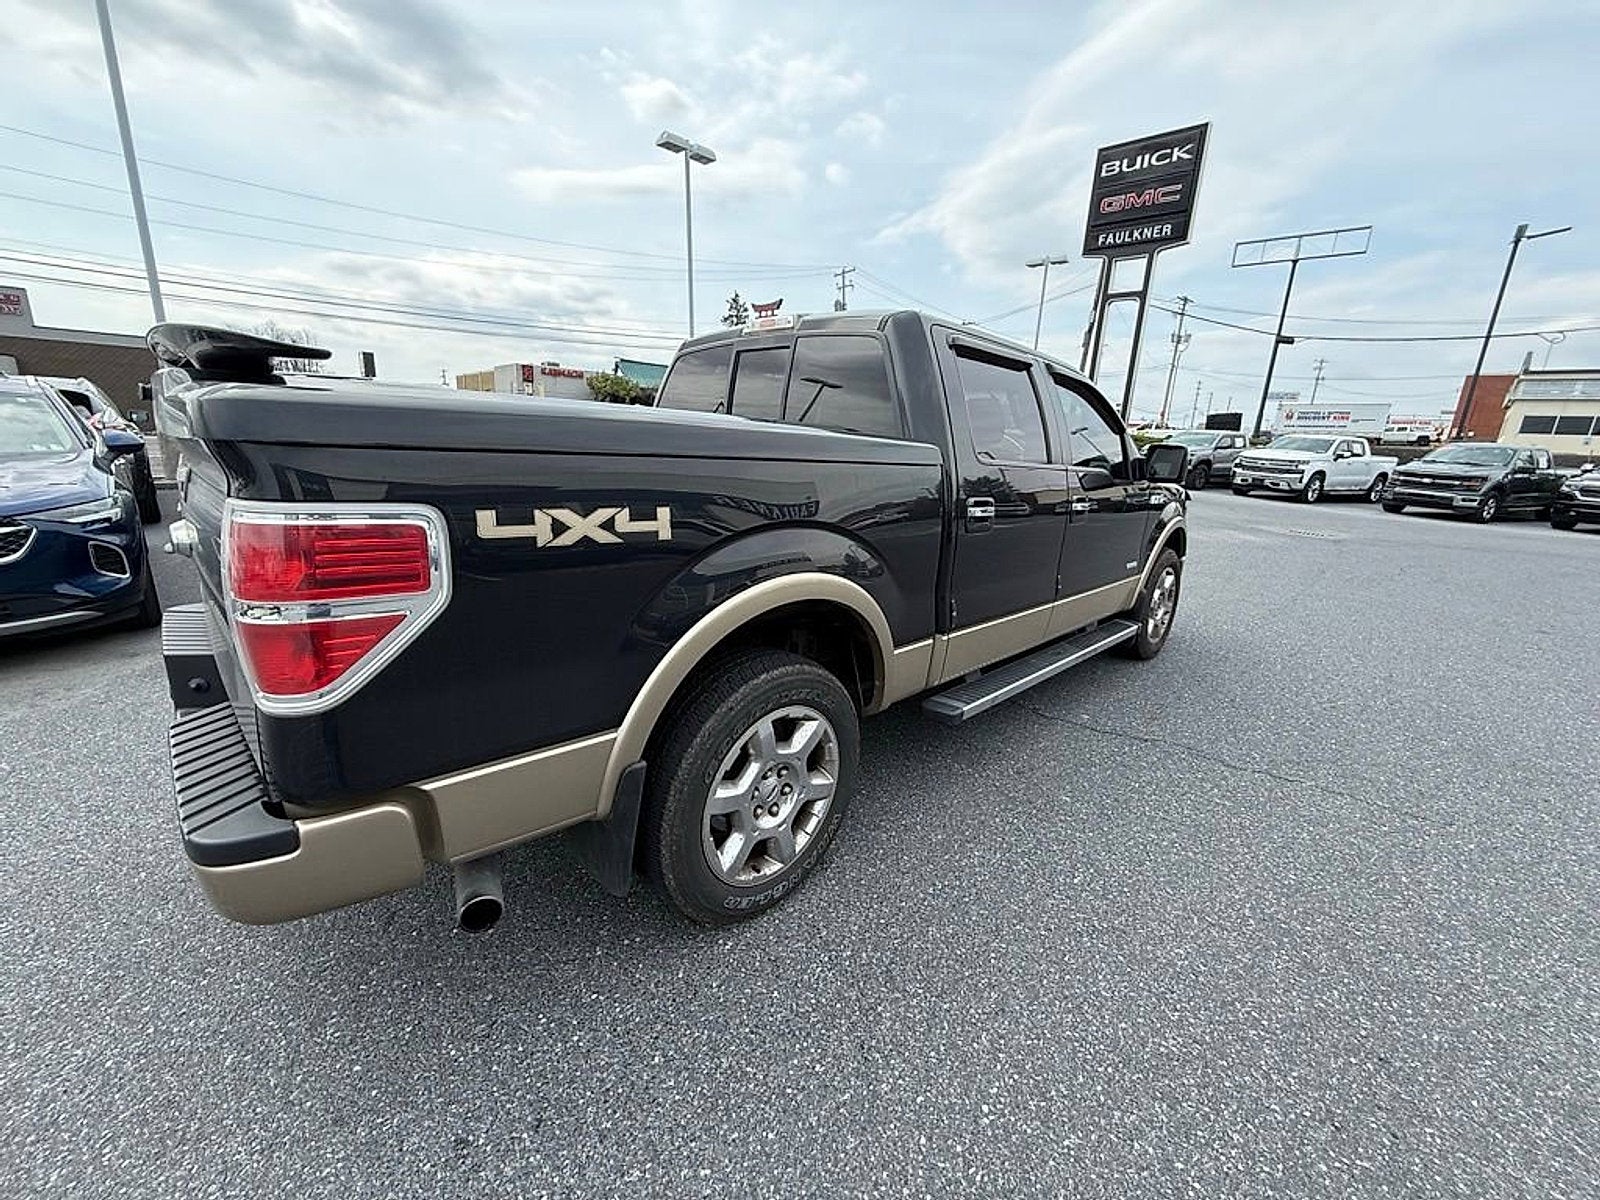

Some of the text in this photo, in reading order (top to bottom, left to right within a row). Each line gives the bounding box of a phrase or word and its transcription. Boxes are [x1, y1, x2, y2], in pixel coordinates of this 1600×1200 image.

[1100, 143, 1195, 177] BUICK
[1100, 184, 1183, 214] GMC
[1098, 224, 1172, 247] FAULKNER
[475, 506, 672, 548] 4X4
